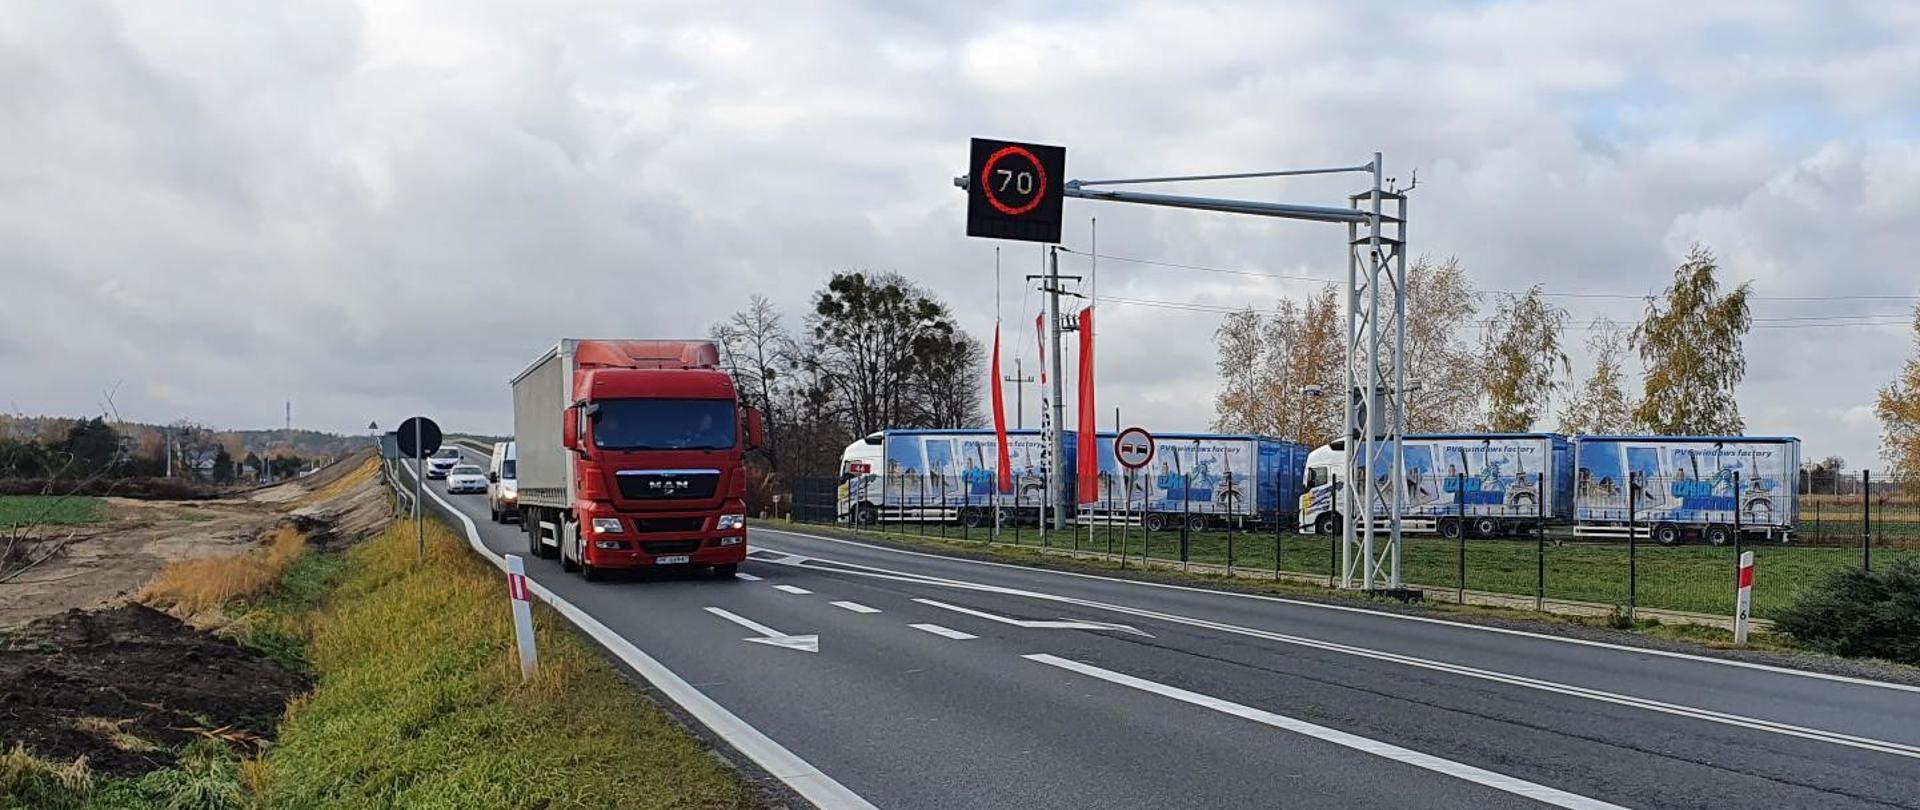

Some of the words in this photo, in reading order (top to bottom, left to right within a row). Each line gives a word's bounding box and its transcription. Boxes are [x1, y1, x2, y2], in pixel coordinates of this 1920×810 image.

[996, 169, 1032, 194] 70
[1212, 446, 1241, 454] factory
[1503, 446, 1536, 454] factory
[1695, 448, 1736, 456] windows
[1737, 449, 1773, 457] factory
[649, 481, 688, 489] MAN
[1739, 610, 1747, 620] 6
